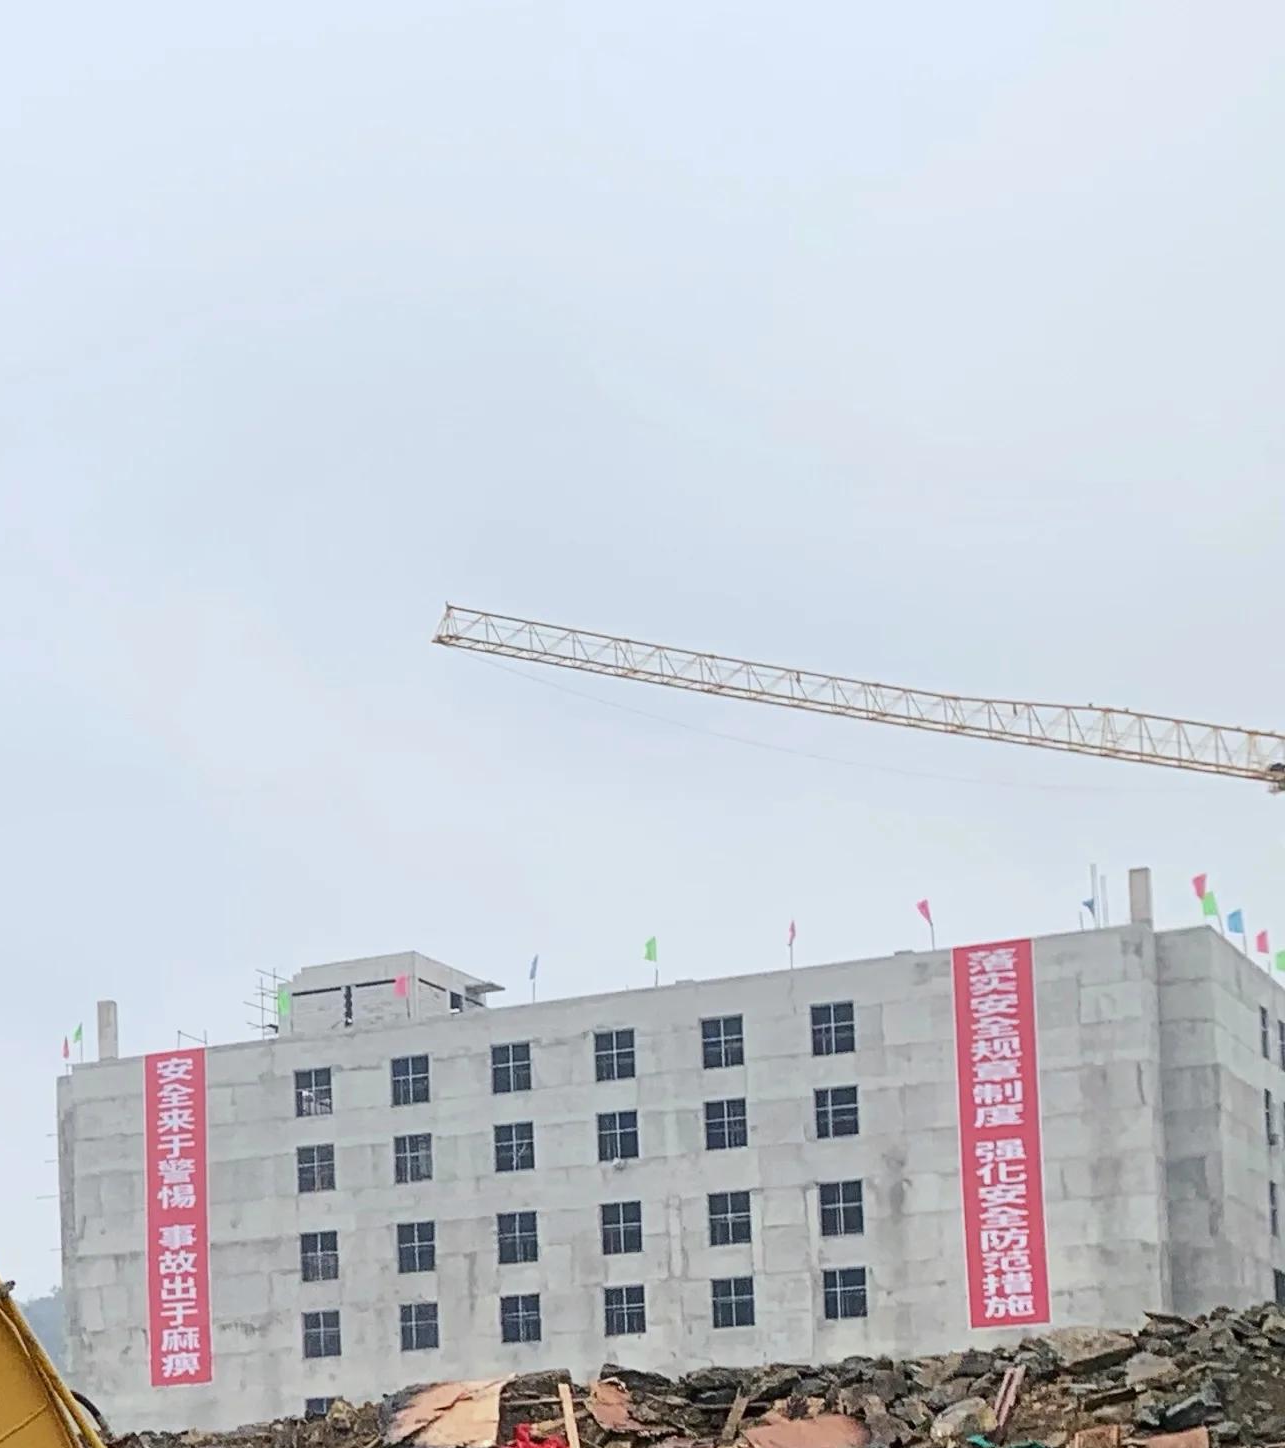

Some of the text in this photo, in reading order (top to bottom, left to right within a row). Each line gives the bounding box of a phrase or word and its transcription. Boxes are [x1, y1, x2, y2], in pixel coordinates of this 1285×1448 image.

[156, 1056, 201, 1378] 安全来于警惕 事故出于麻痹
[968, 947, 1034, 1320] 落实安全规章制度 强化安全防范措施
